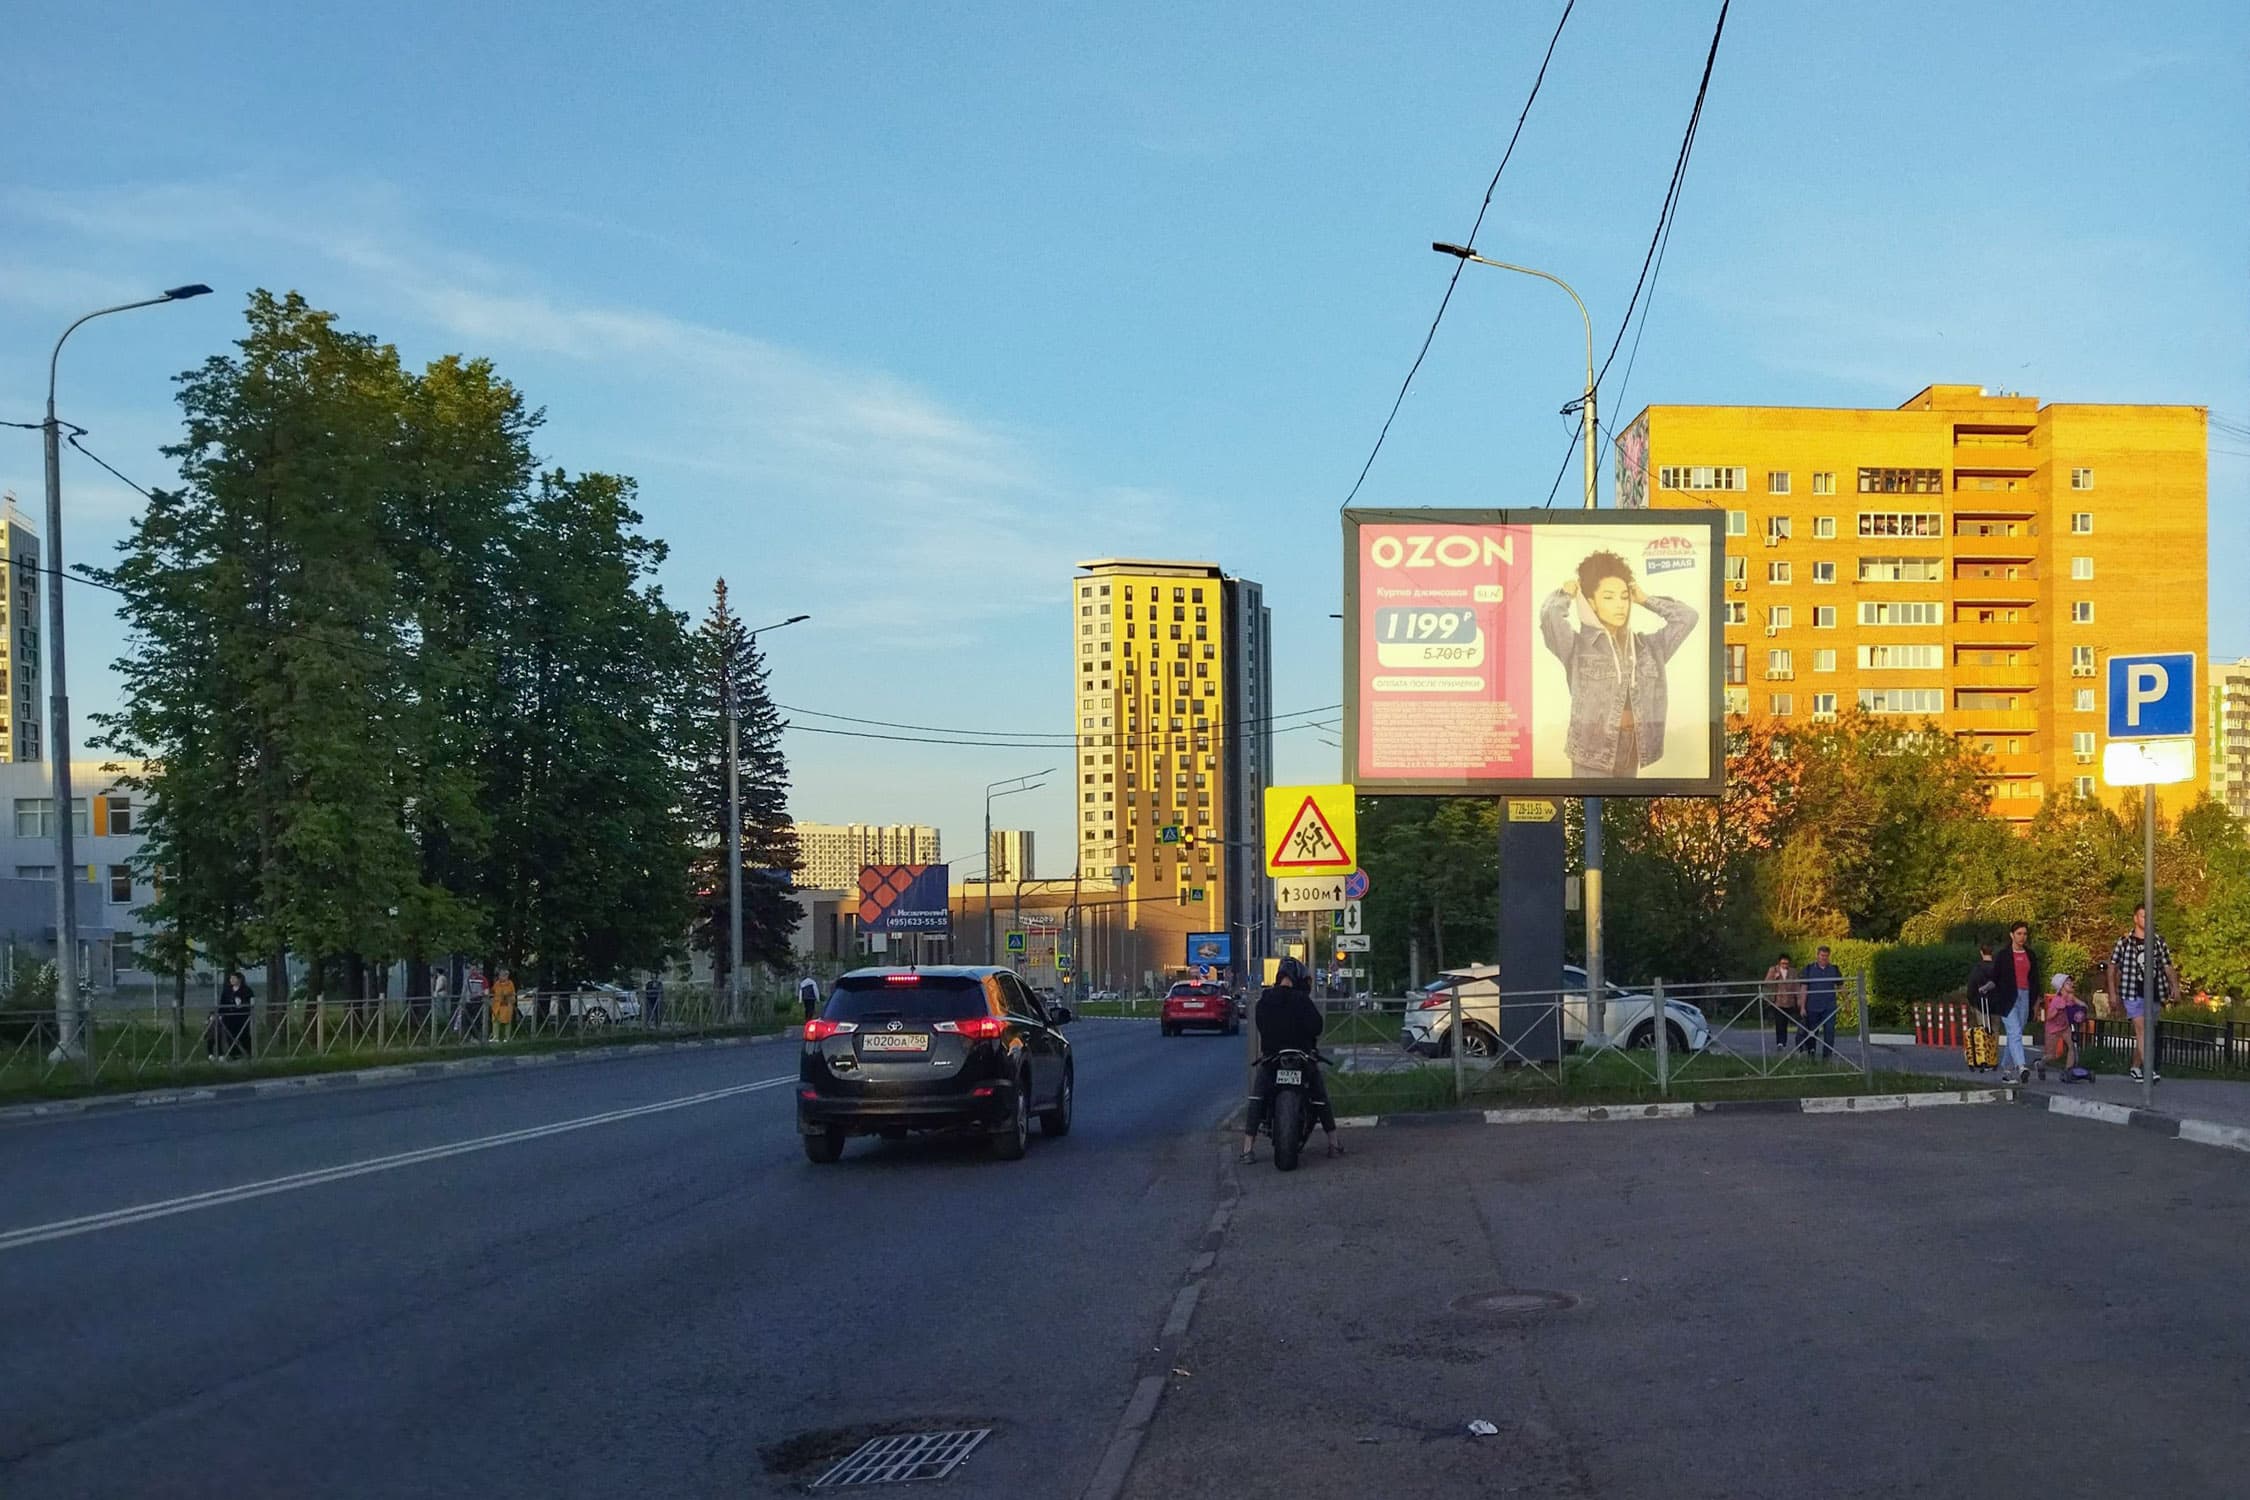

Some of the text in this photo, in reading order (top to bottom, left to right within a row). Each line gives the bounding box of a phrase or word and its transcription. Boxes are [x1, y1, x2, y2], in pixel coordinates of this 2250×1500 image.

[1371, 535, 1514, 568] OZON
[2127, 663, 2169, 727] P
[1293, 888, 1331, 900] 300м
